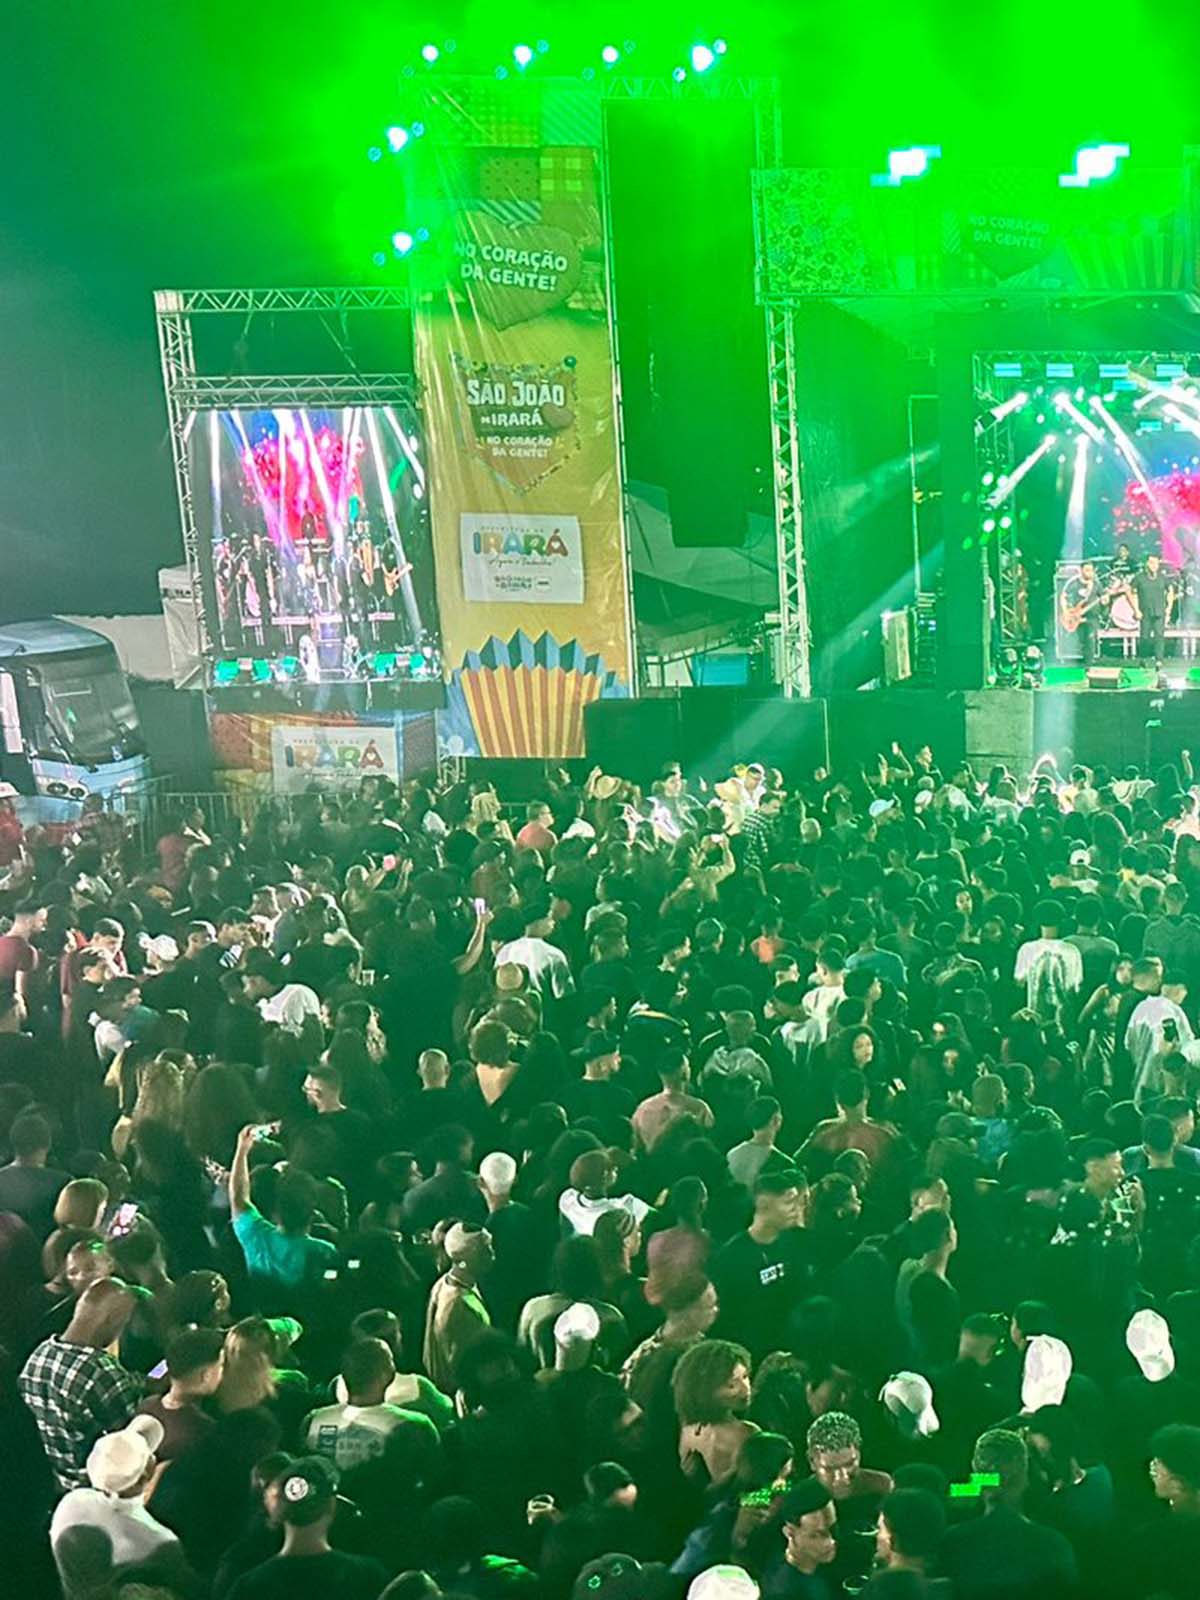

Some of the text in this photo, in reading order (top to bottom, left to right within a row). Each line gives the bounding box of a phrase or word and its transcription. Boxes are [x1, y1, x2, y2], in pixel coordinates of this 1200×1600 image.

[481, 245, 568, 272] CORAÇÃO
[461, 263, 557, 292] DA GENTE!
[467, 378, 565, 407] SÃO JOÃO
[491, 408, 543, 427] IRARÁ
[473, 528, 568, 557] IRARÁ
[285, 739, 384, 768] IRARÁ
